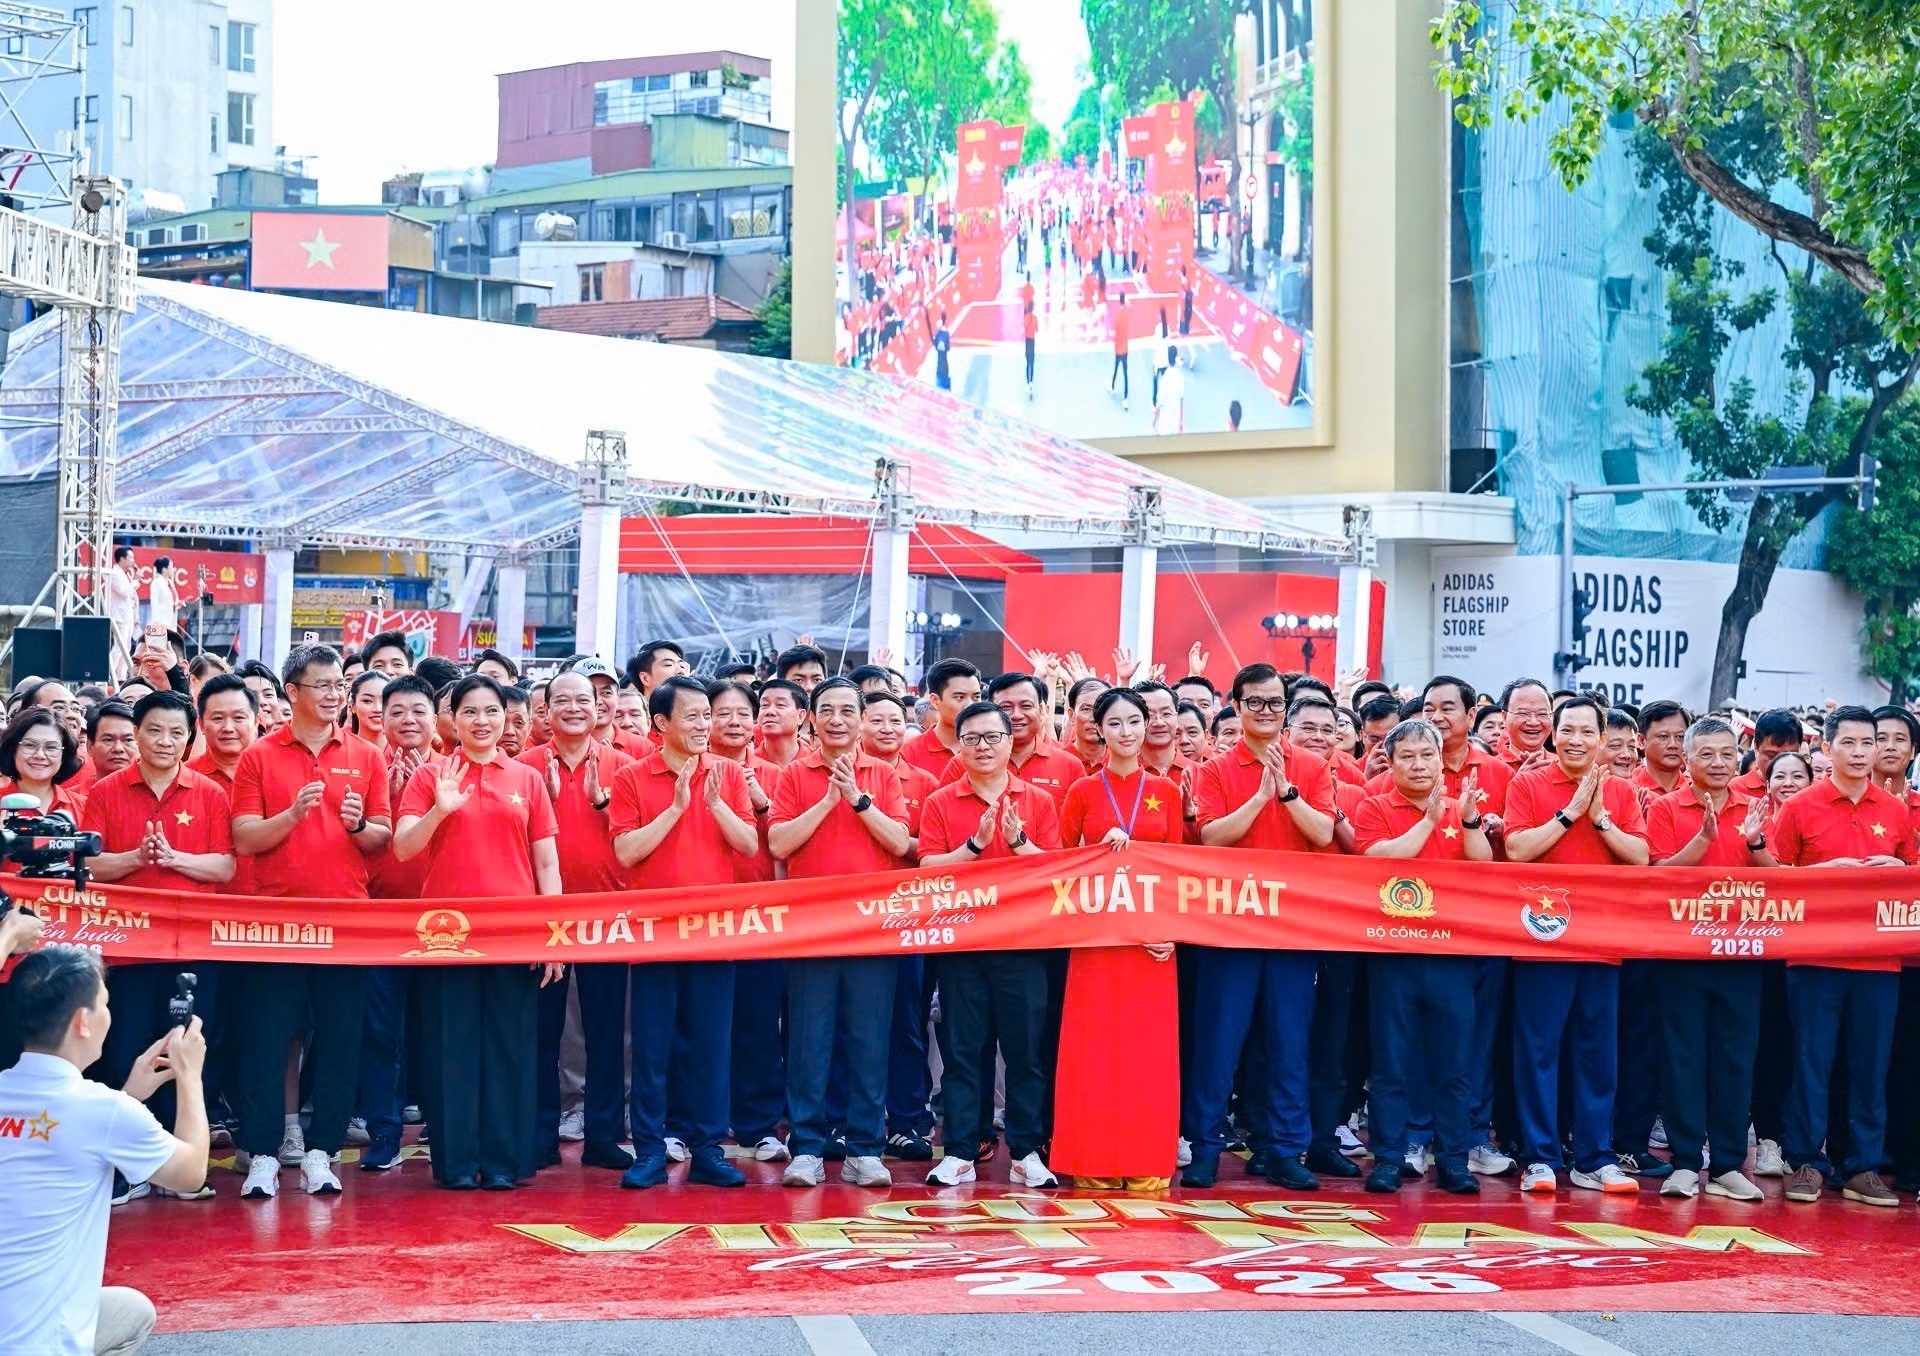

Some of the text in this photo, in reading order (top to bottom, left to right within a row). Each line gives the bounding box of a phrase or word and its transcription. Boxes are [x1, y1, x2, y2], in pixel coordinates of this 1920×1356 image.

[1442, 573, 1495, 591] ADIDAS
[1573, 571, 1662, 614] DIDAS
[1443, 596, 1510, 613] FLAGSHIP
[1442, 619, 1486, 636] STORE
[1574, 627, 1689, 668] LAGSHIP
[896, 874, 956, 896] CÙNG
[1050, 864, 1287, 917] XUẤT PHÁT
[1708, 876, 1767, 898] CÙNG
[856, 885, 999, 916] VIỆT NAM
[1668, 893, 1805, 925] VIỆT NAM
[79, 906, 151, 929] NAM
[544, 904, 790, 947] XUẤT PHÁT
[880, 904, 977, 930] tiến bước
[1690, 916, 1785, 937] tiến bước
[73, 919, 129, 943] bước
[211, 920, 334, 944] Nhân Dân
[900, 927, 956, 947] 2026
[1366, 924, 1451, 940] BỘ CÔNG AN
[1711, 938, 1764, 956] 2026
[866, 1192, 1391, 1223] CÙNG
[495, 1216, 1820, 1256] VIỆT NAM
[746, 1239, 1667, 1271] tiến bước
[954, 1270, 1503, 1296] 2026
